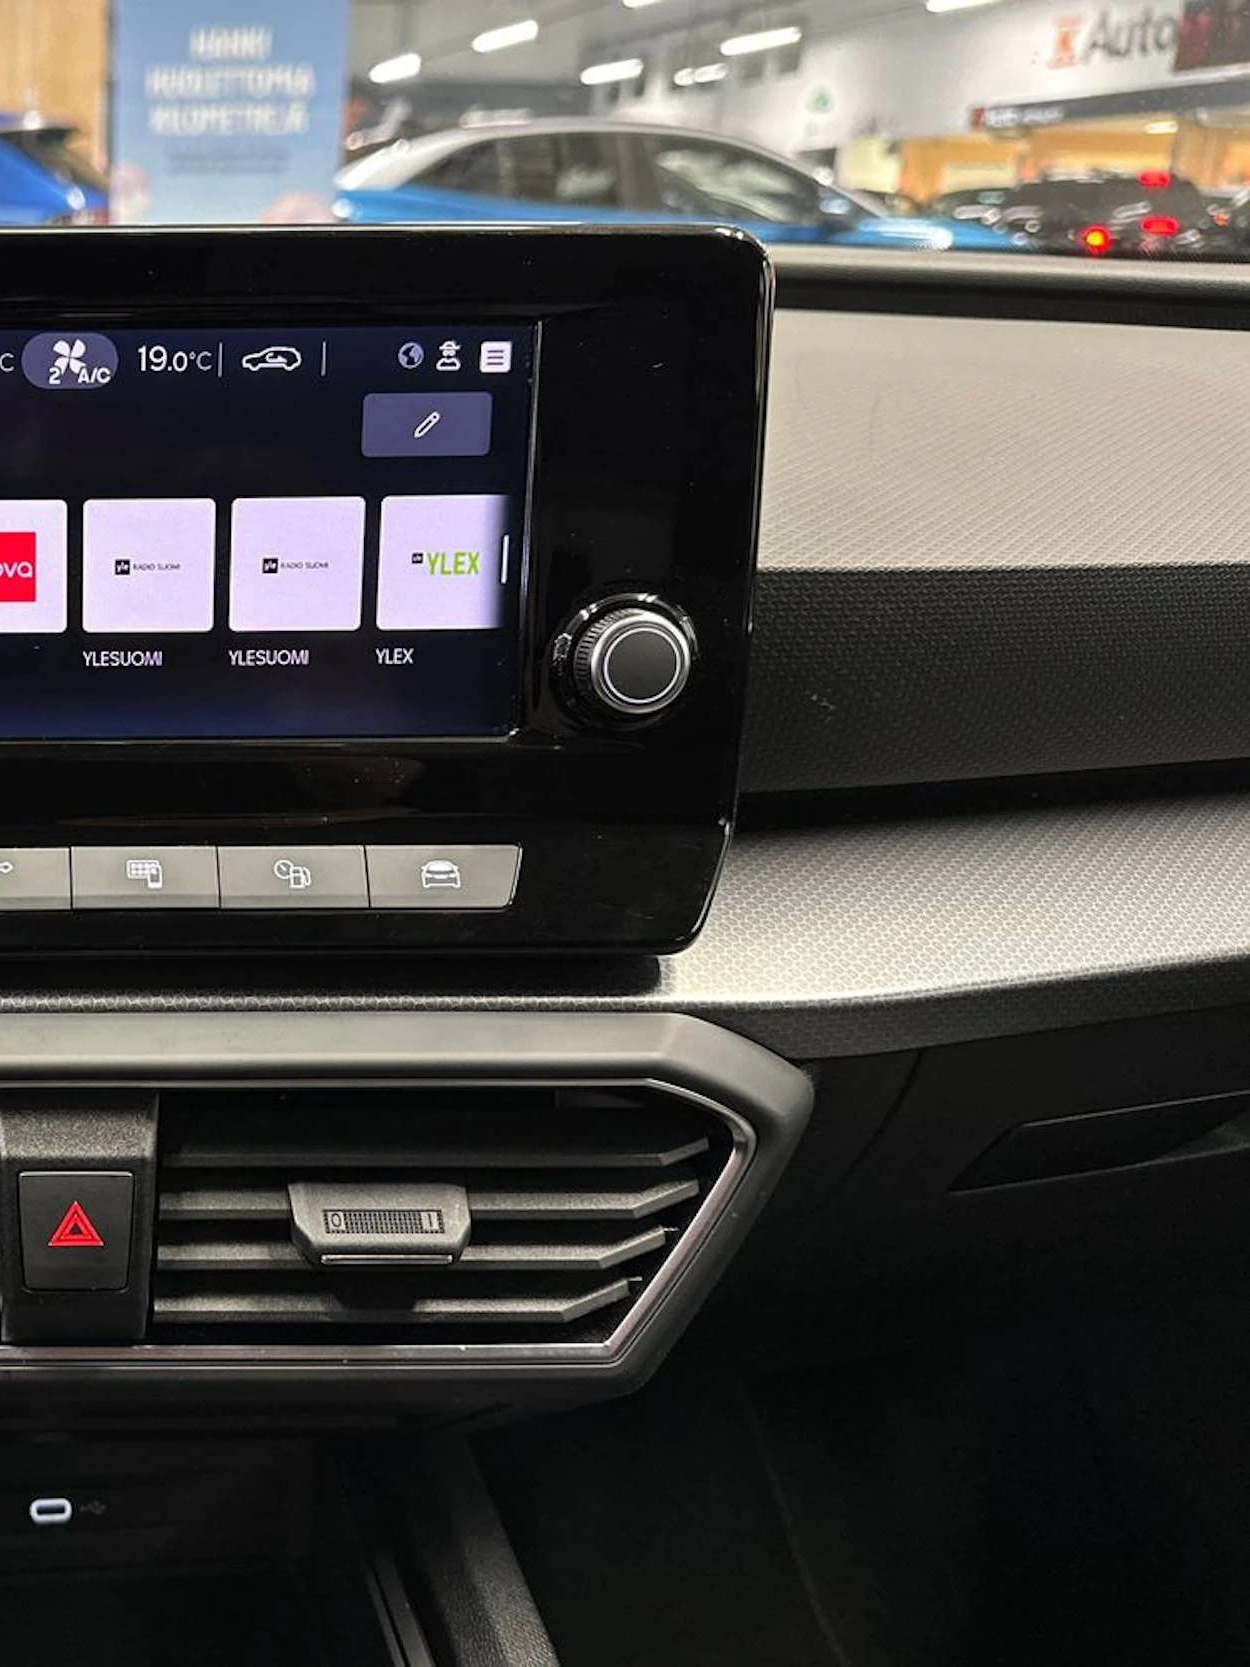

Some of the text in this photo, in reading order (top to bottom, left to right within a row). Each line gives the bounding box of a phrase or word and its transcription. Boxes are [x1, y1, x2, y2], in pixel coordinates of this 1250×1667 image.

[48, 366, 61, 385] 2
[77, 366, 112, 385] A/C
[427, 551, 480, 575] YLEX
[83, 650, 163, 667] YLESUOMI
[229, 649, 310, 666] YLESUOMI
[376, 648, 414, 665] YLEX
